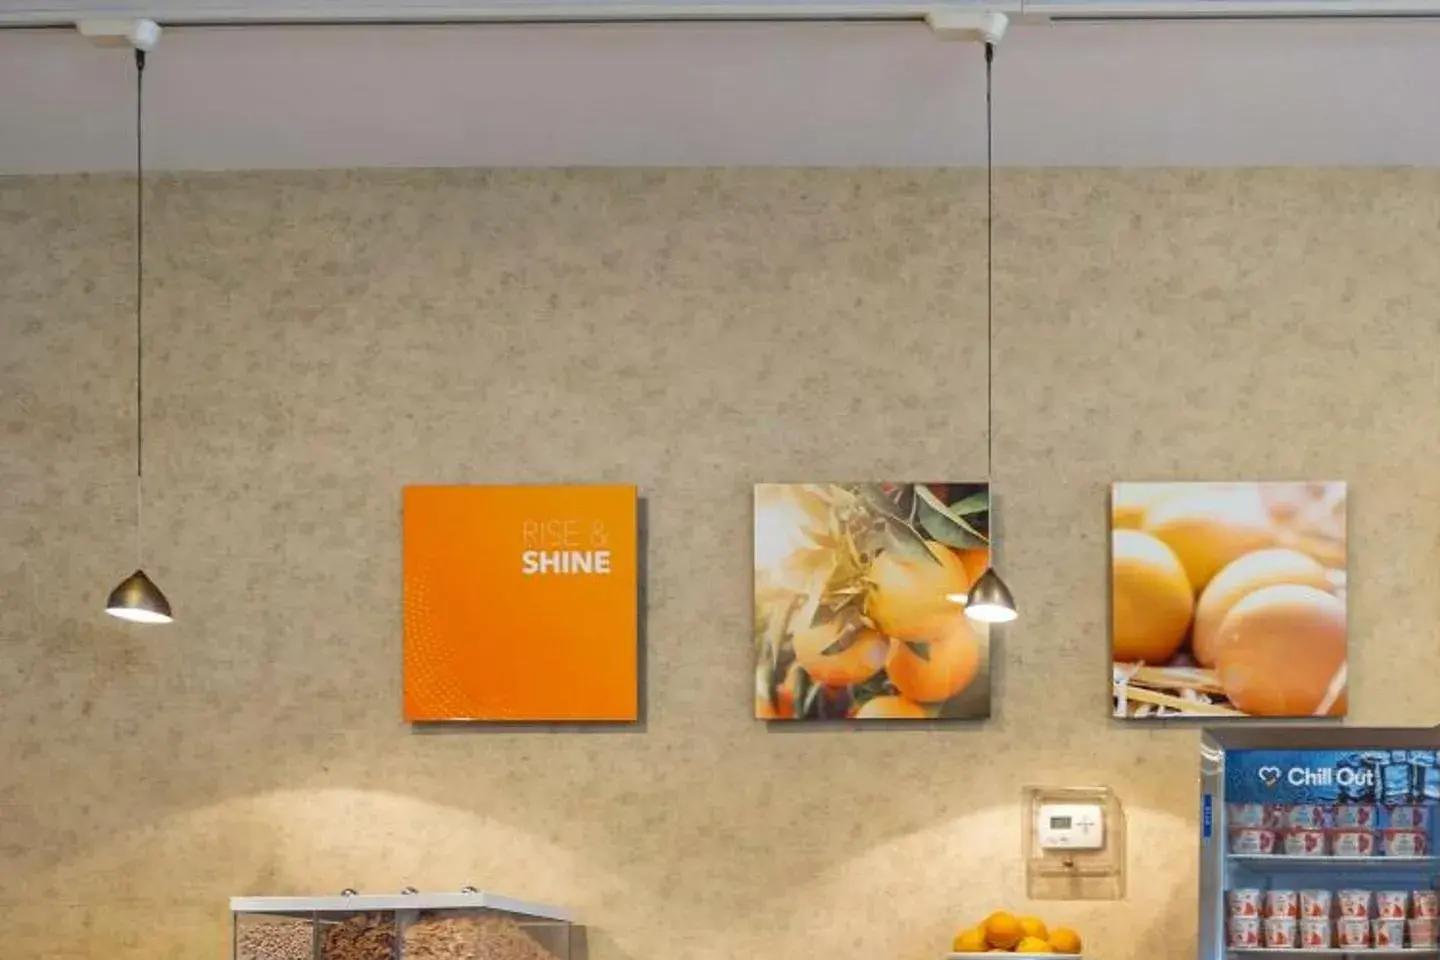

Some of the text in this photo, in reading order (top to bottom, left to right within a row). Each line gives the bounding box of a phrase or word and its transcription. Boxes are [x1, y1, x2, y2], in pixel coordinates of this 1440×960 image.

[522, 518, 610, 546] RISE &
[521, 550, 612, 574] SHINE
[1287, 767, 1374, 786] Chill Out
